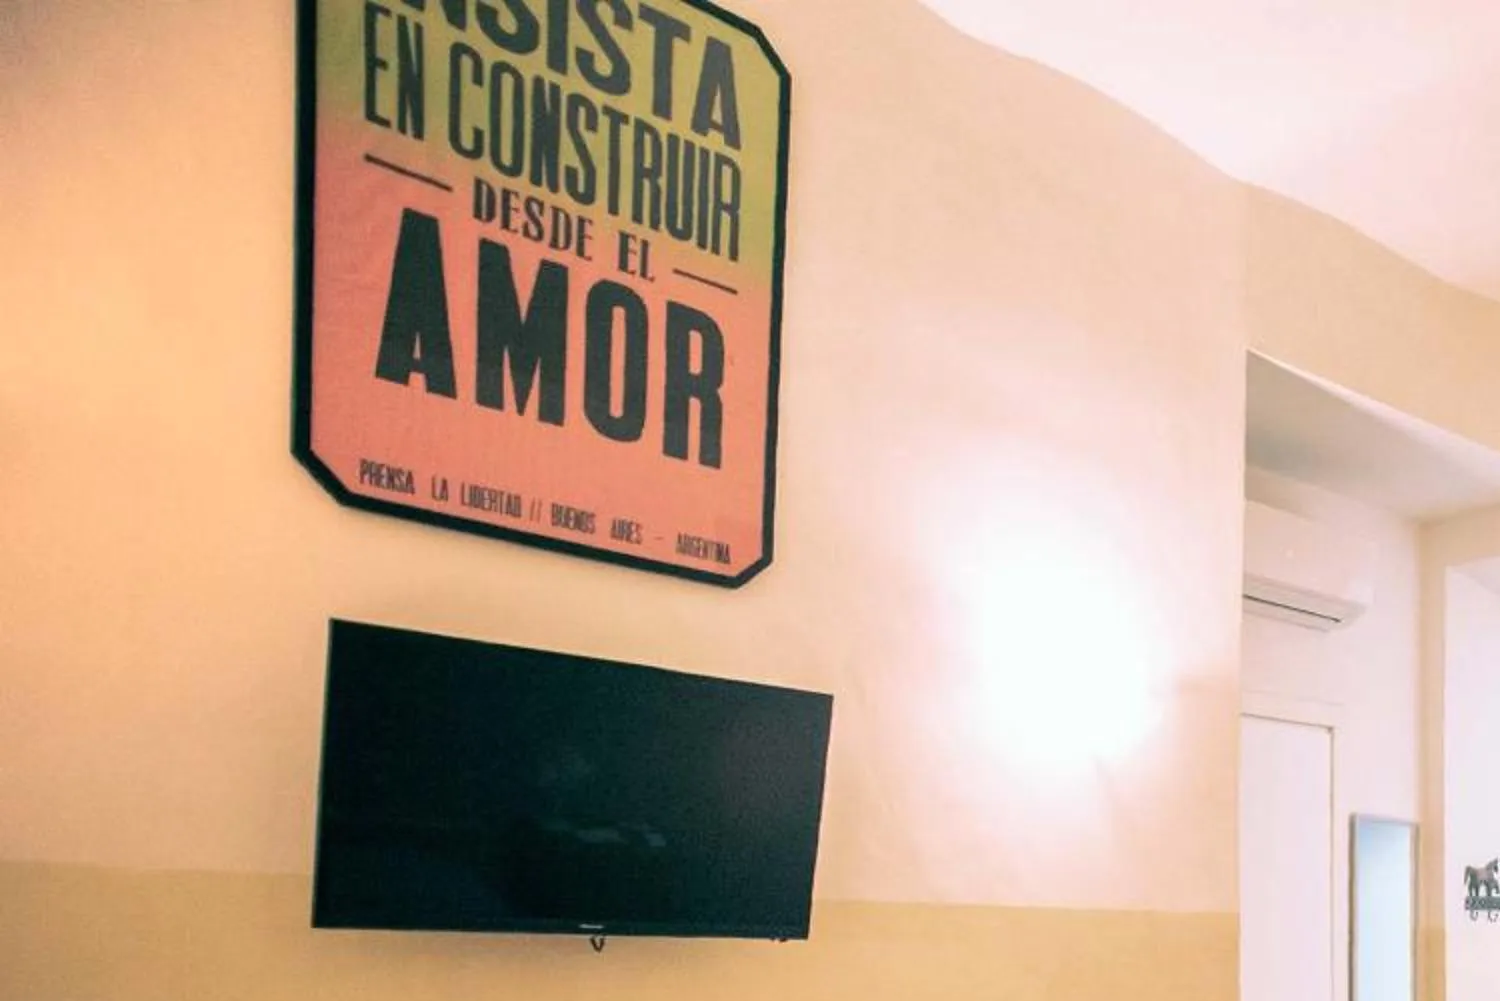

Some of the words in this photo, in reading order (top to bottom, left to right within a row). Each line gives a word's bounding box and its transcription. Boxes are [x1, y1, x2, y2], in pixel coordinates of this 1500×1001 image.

[364, 1, 425, 142] EN
[448, 41, 742, 262] CONSTRUIR
[400, 0, 742, 151] ISTA
[472, 177, 594, 262] DESDE
[617, 230, 656, 283] EL
[375, 207, 725, 469] AMOR
[359, 458, 416, 495] PRENSA
[431, 474, 449, 502] LA
[460, 482, 523, 518] LIBERTAD
[550, 502, 597, 535] BUENOS
[610, 516, 644, 545] AIRES
[675, 531, 731, 565] ARGENTINA
